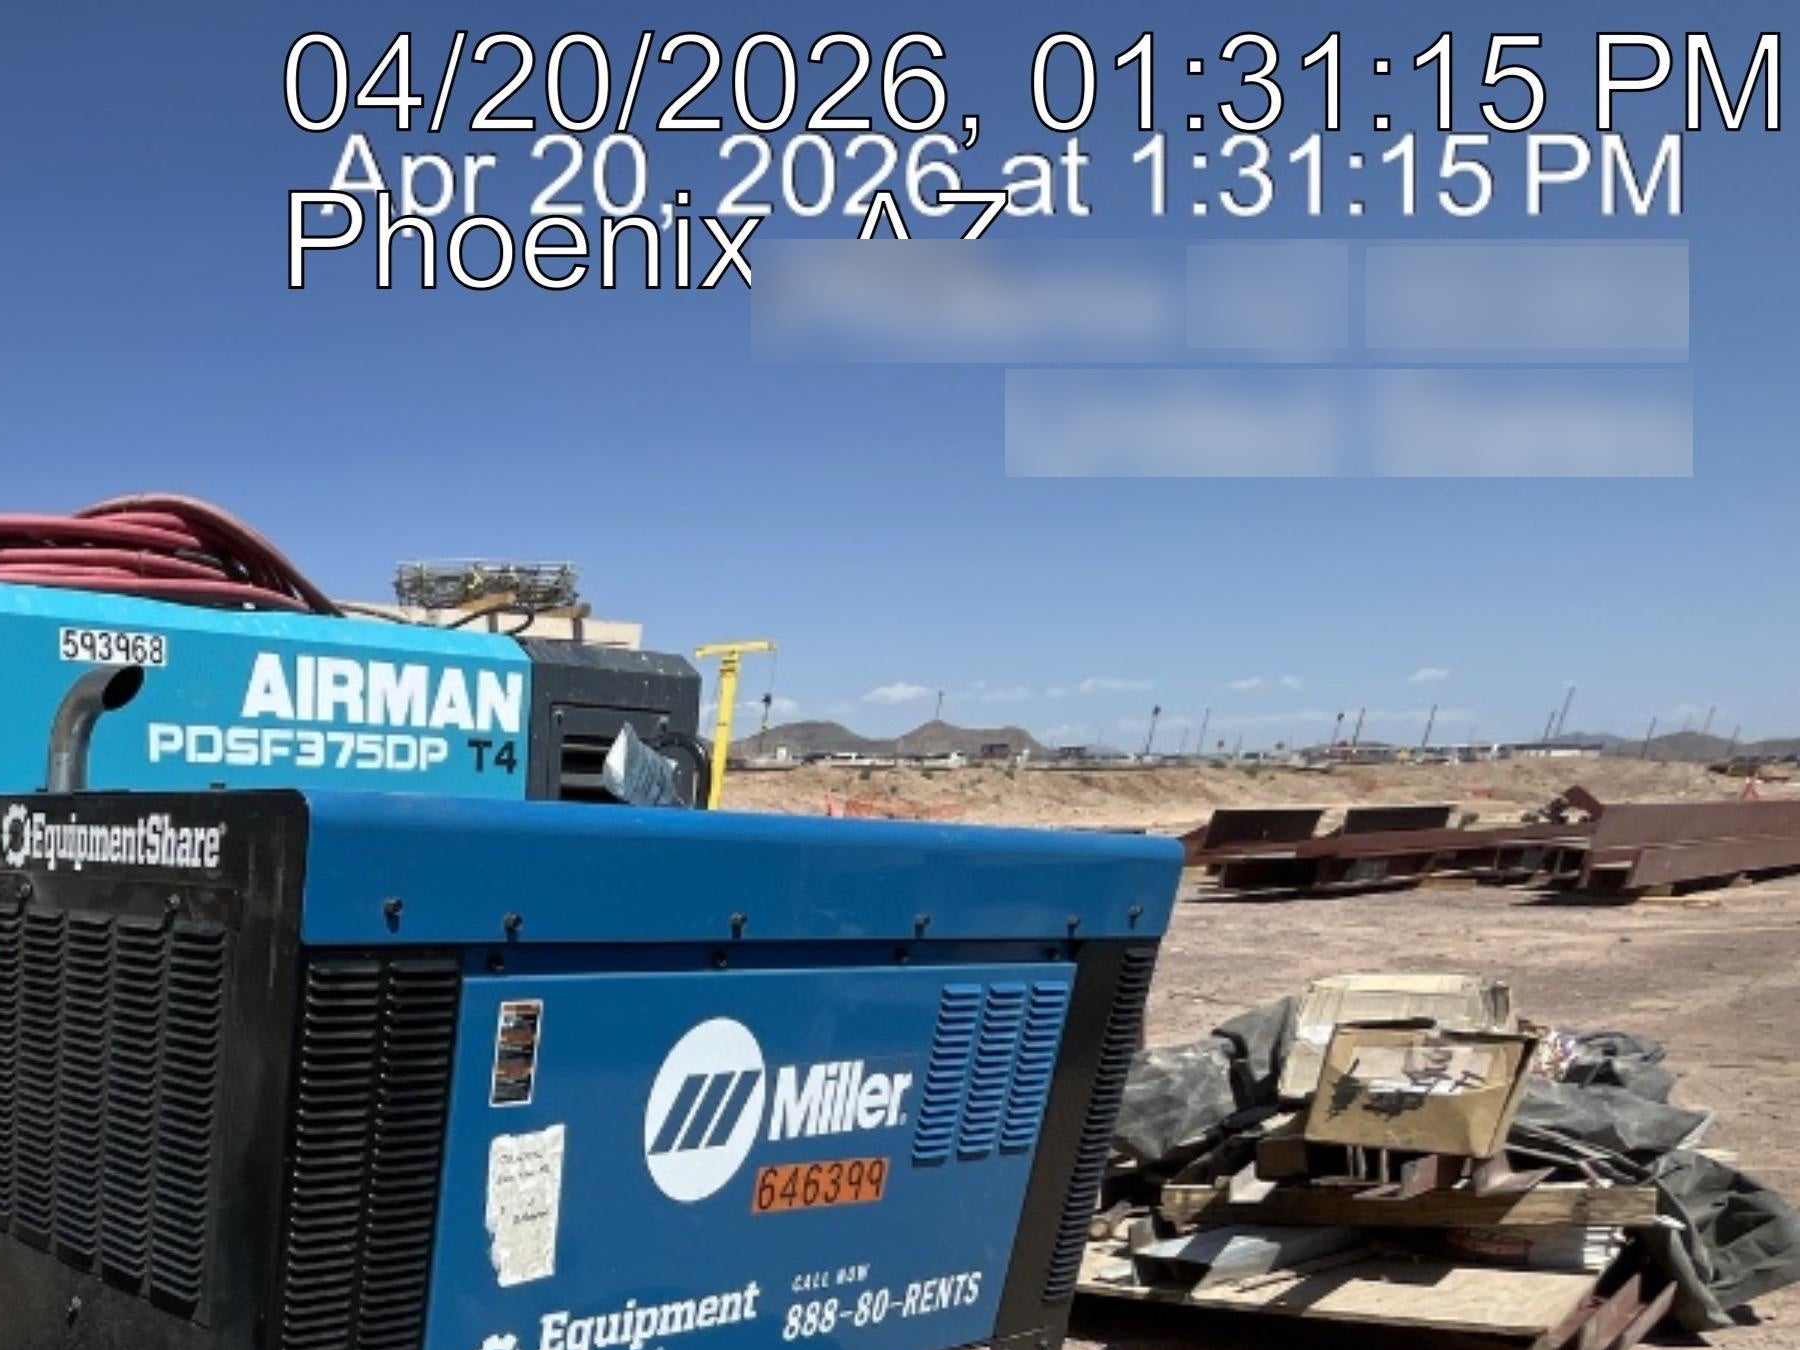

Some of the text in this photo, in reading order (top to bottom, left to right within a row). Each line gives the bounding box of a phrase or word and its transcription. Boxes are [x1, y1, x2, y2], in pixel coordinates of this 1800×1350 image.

[63, 629, 163, 664] 593968
[240, 651, 524, 733] AIRMAN
[147, 722, 518, 775] PDSF375DP T4
[31, 812, 221, 871] EquipmentShare
[767, 1058, 913, 1142] Miller
[757, 1159, 885, 1210] 646399
[782, 1270, 983, 1342] 888-80-RENTS
[791, 1271, 830, 1293] CALL
